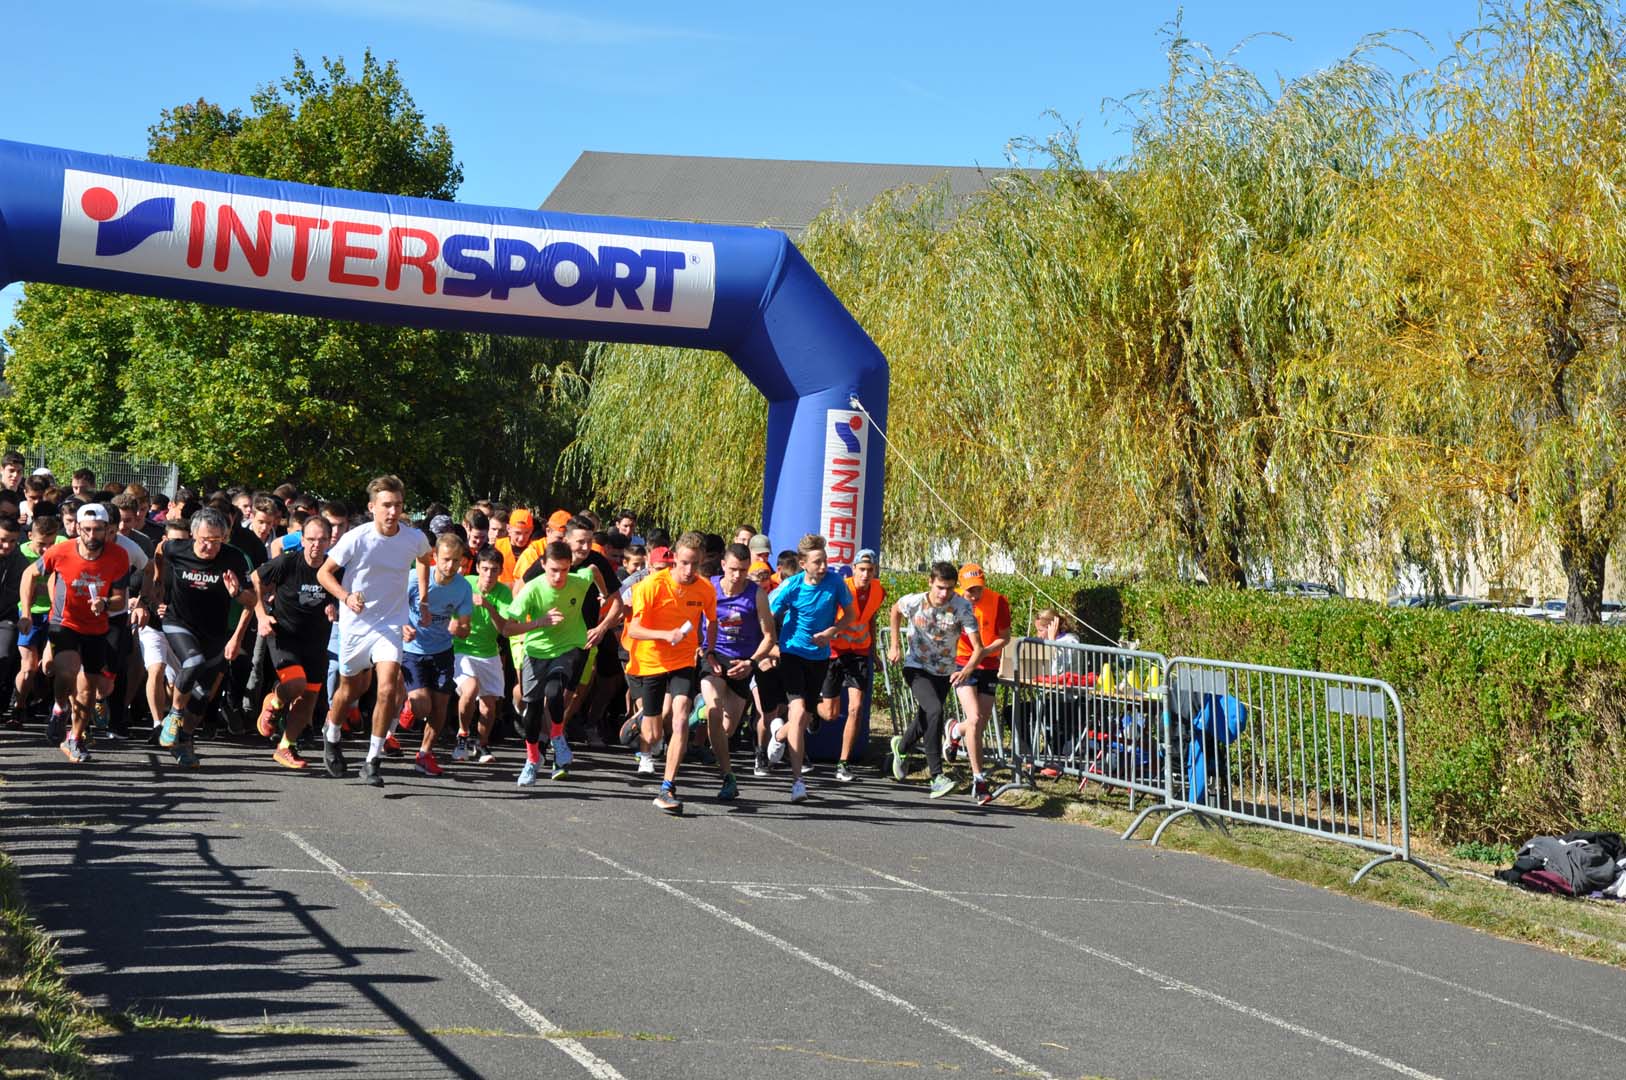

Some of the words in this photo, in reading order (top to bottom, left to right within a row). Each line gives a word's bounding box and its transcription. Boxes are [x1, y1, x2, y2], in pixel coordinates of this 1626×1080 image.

[187, 200, 686, 312] INTERSPORT
[182, 570, 202, 582] MUD
[202, 573, 219, 583] DAY
